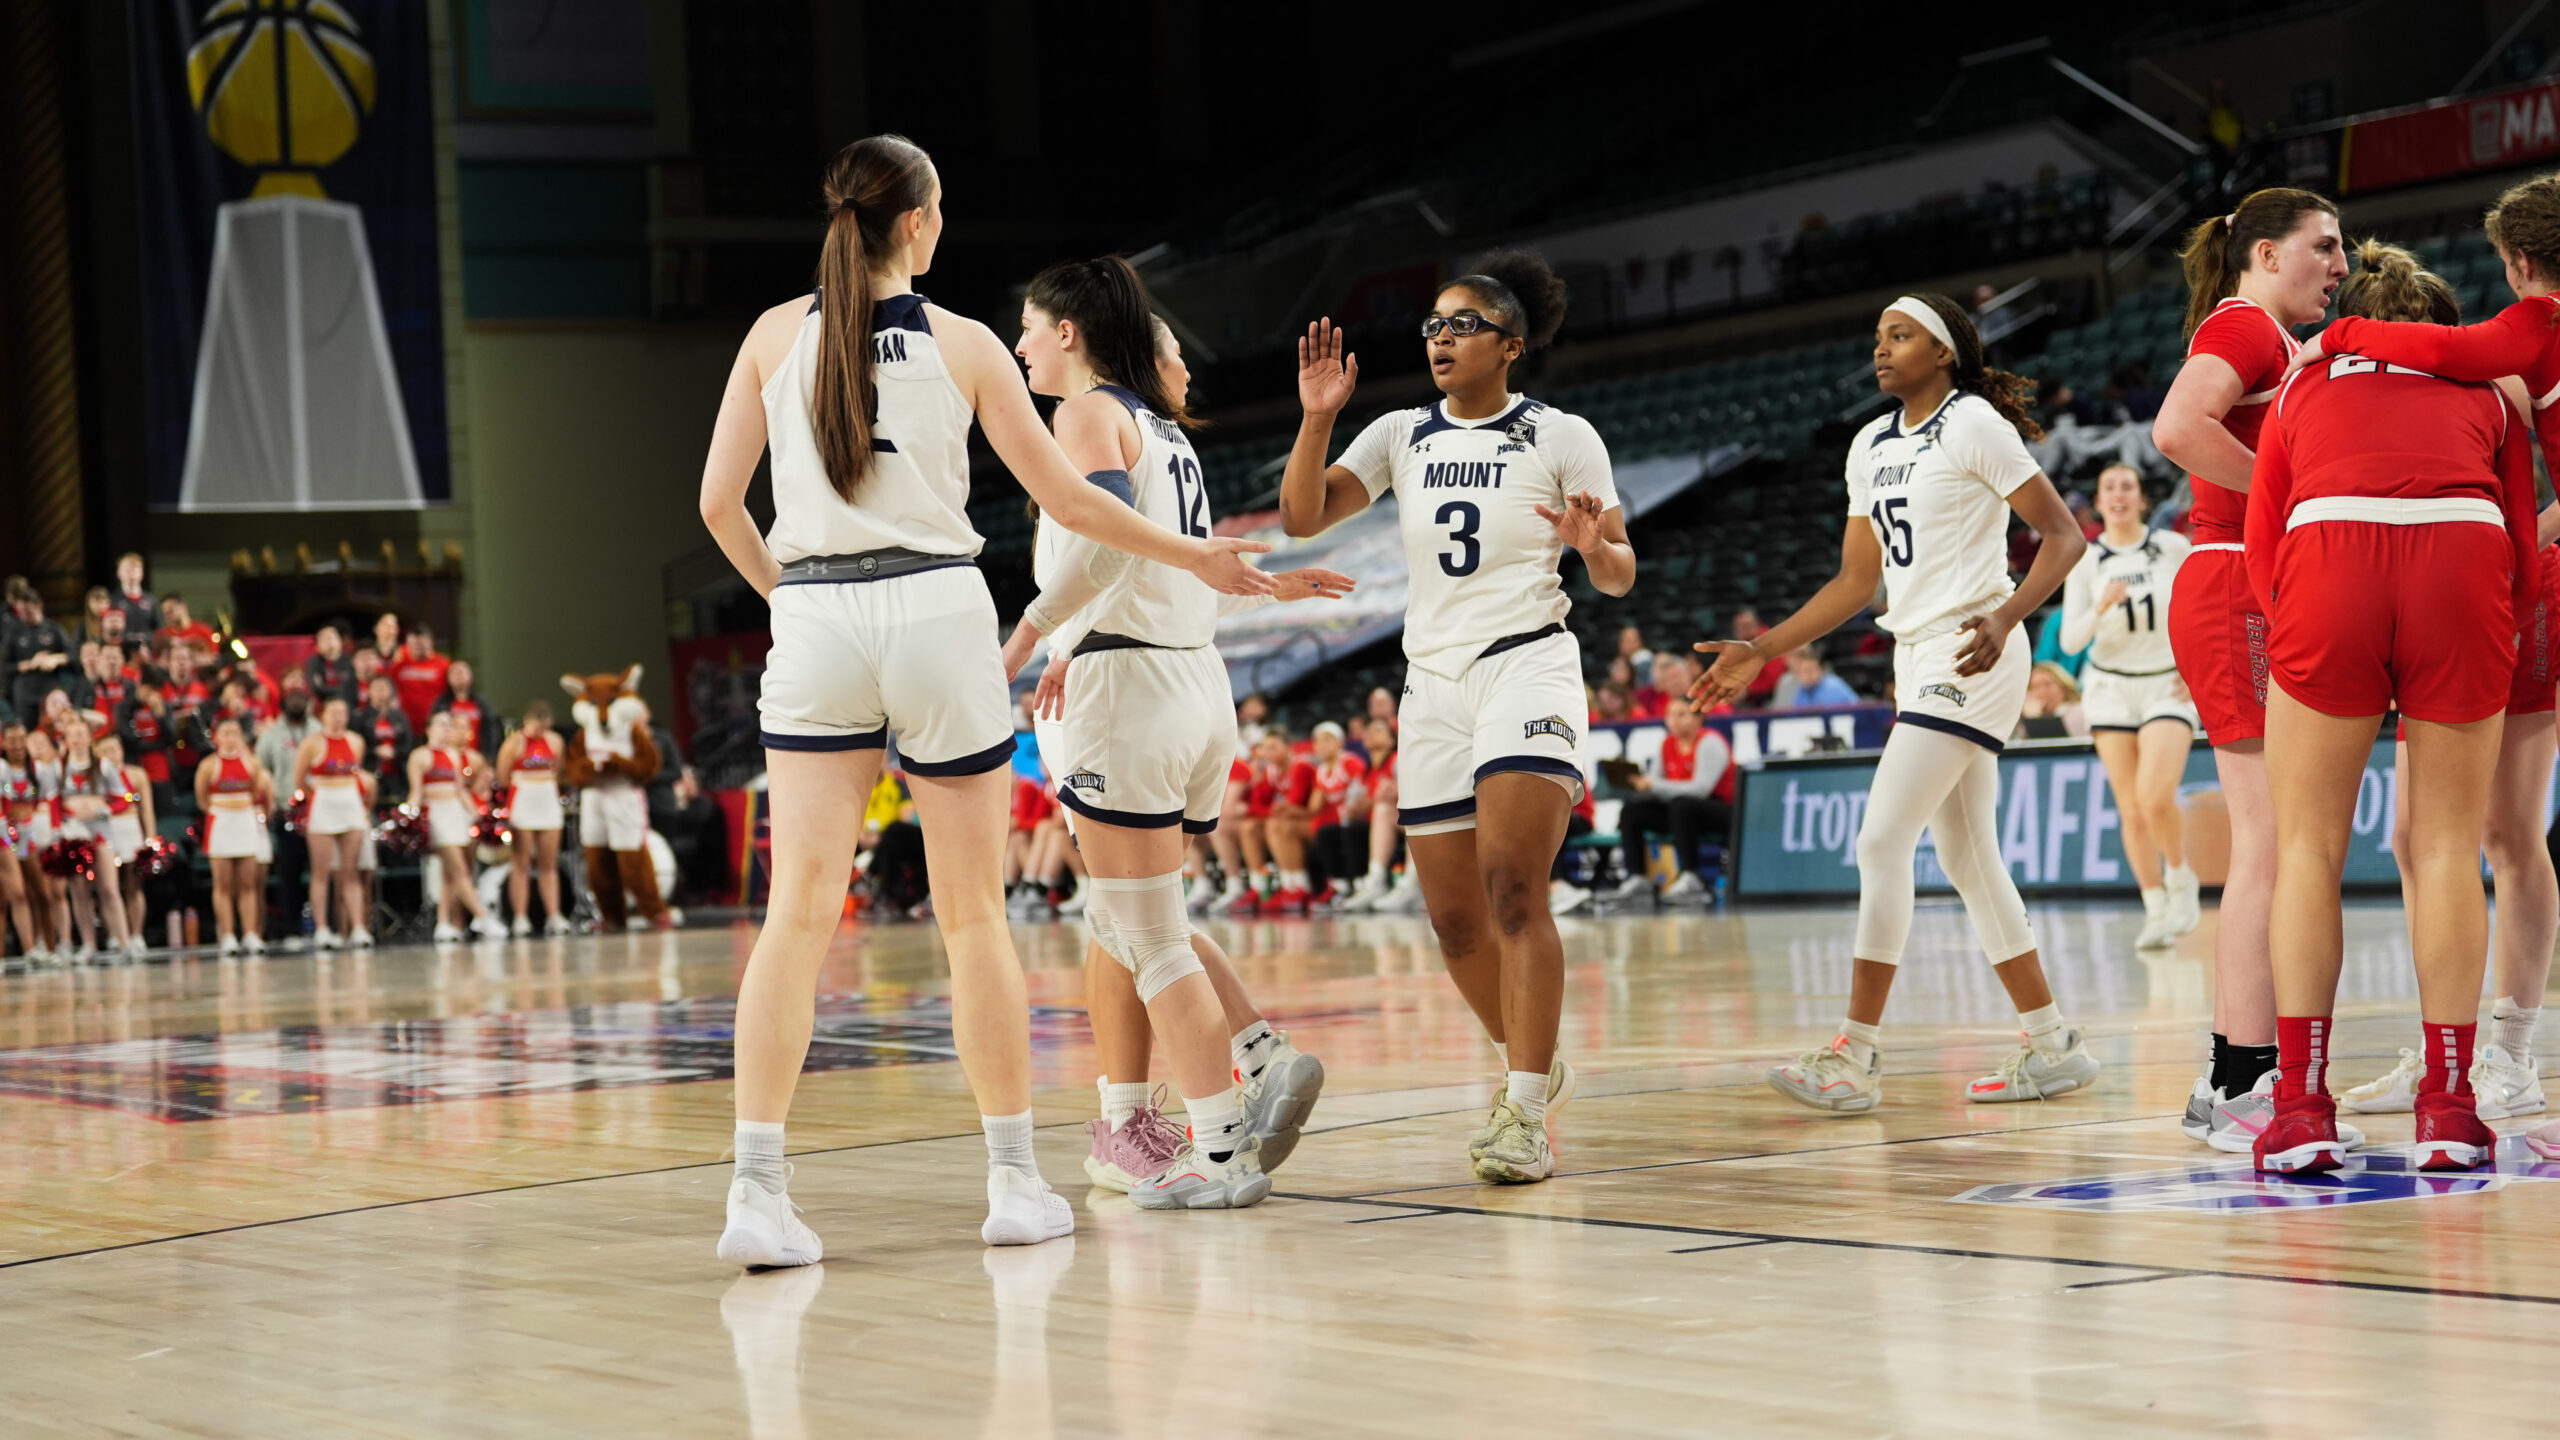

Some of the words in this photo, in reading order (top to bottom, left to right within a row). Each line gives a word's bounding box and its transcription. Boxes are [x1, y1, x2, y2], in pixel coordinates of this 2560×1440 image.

[1497, 443, 1526, 456] MAAC
[1423, 462, 1507, 489] MOUNT
[1872, 462, 1917, 488] MOUNT
[1168, 453, 1207, 540] 12
[1435, 500, 1481, 578] 3
[1871, 497, 1913, 568] 15
[2118, 593, 2155, 632] 11
[2246, 613, 2265, 649] RED
[2250, 649, 2270, 706] FOXES
[2532, 648, 2548, 682] RED
[1938, 685, 1967, 707] MOUNT
[1525, 720, 1548, 738] THE
[1549, 721, 1576, 749] MOUNT
[1074, 774, 1105, 793] MOUNT
